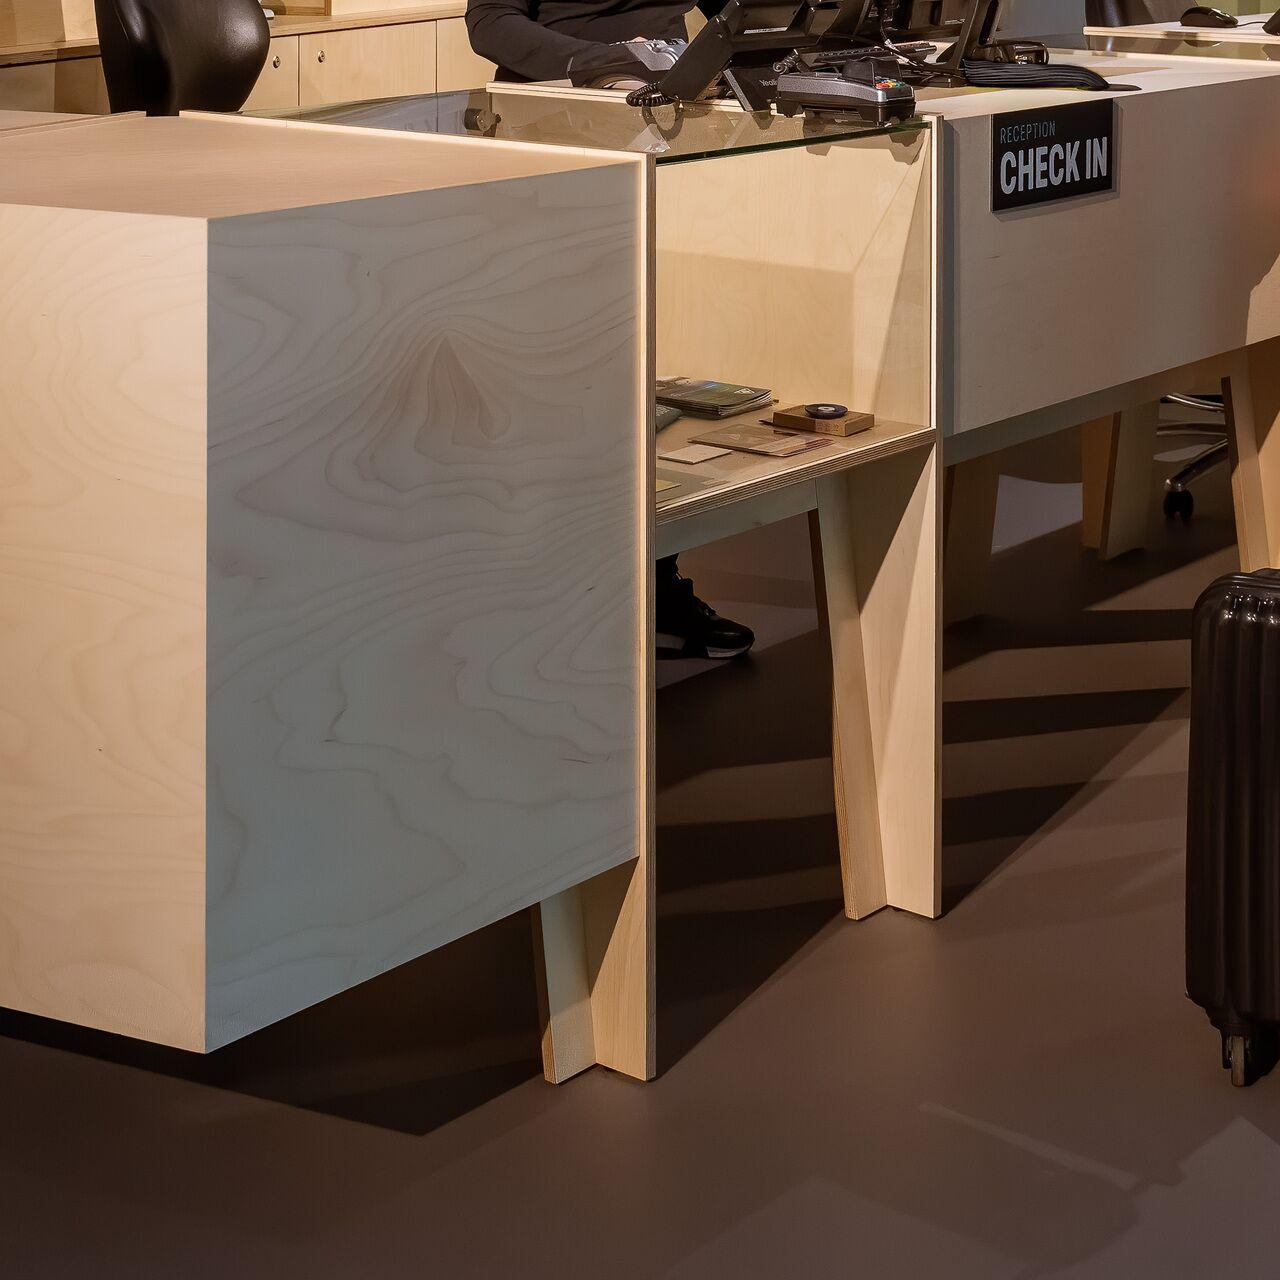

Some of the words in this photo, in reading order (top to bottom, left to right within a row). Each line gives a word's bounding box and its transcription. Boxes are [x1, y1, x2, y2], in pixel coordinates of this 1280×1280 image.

[1000, 120, 1056, 144] RECEPTION
[1000, 140, 1080, 195] CHECK
[1085, 136, 1108, 180] IN
